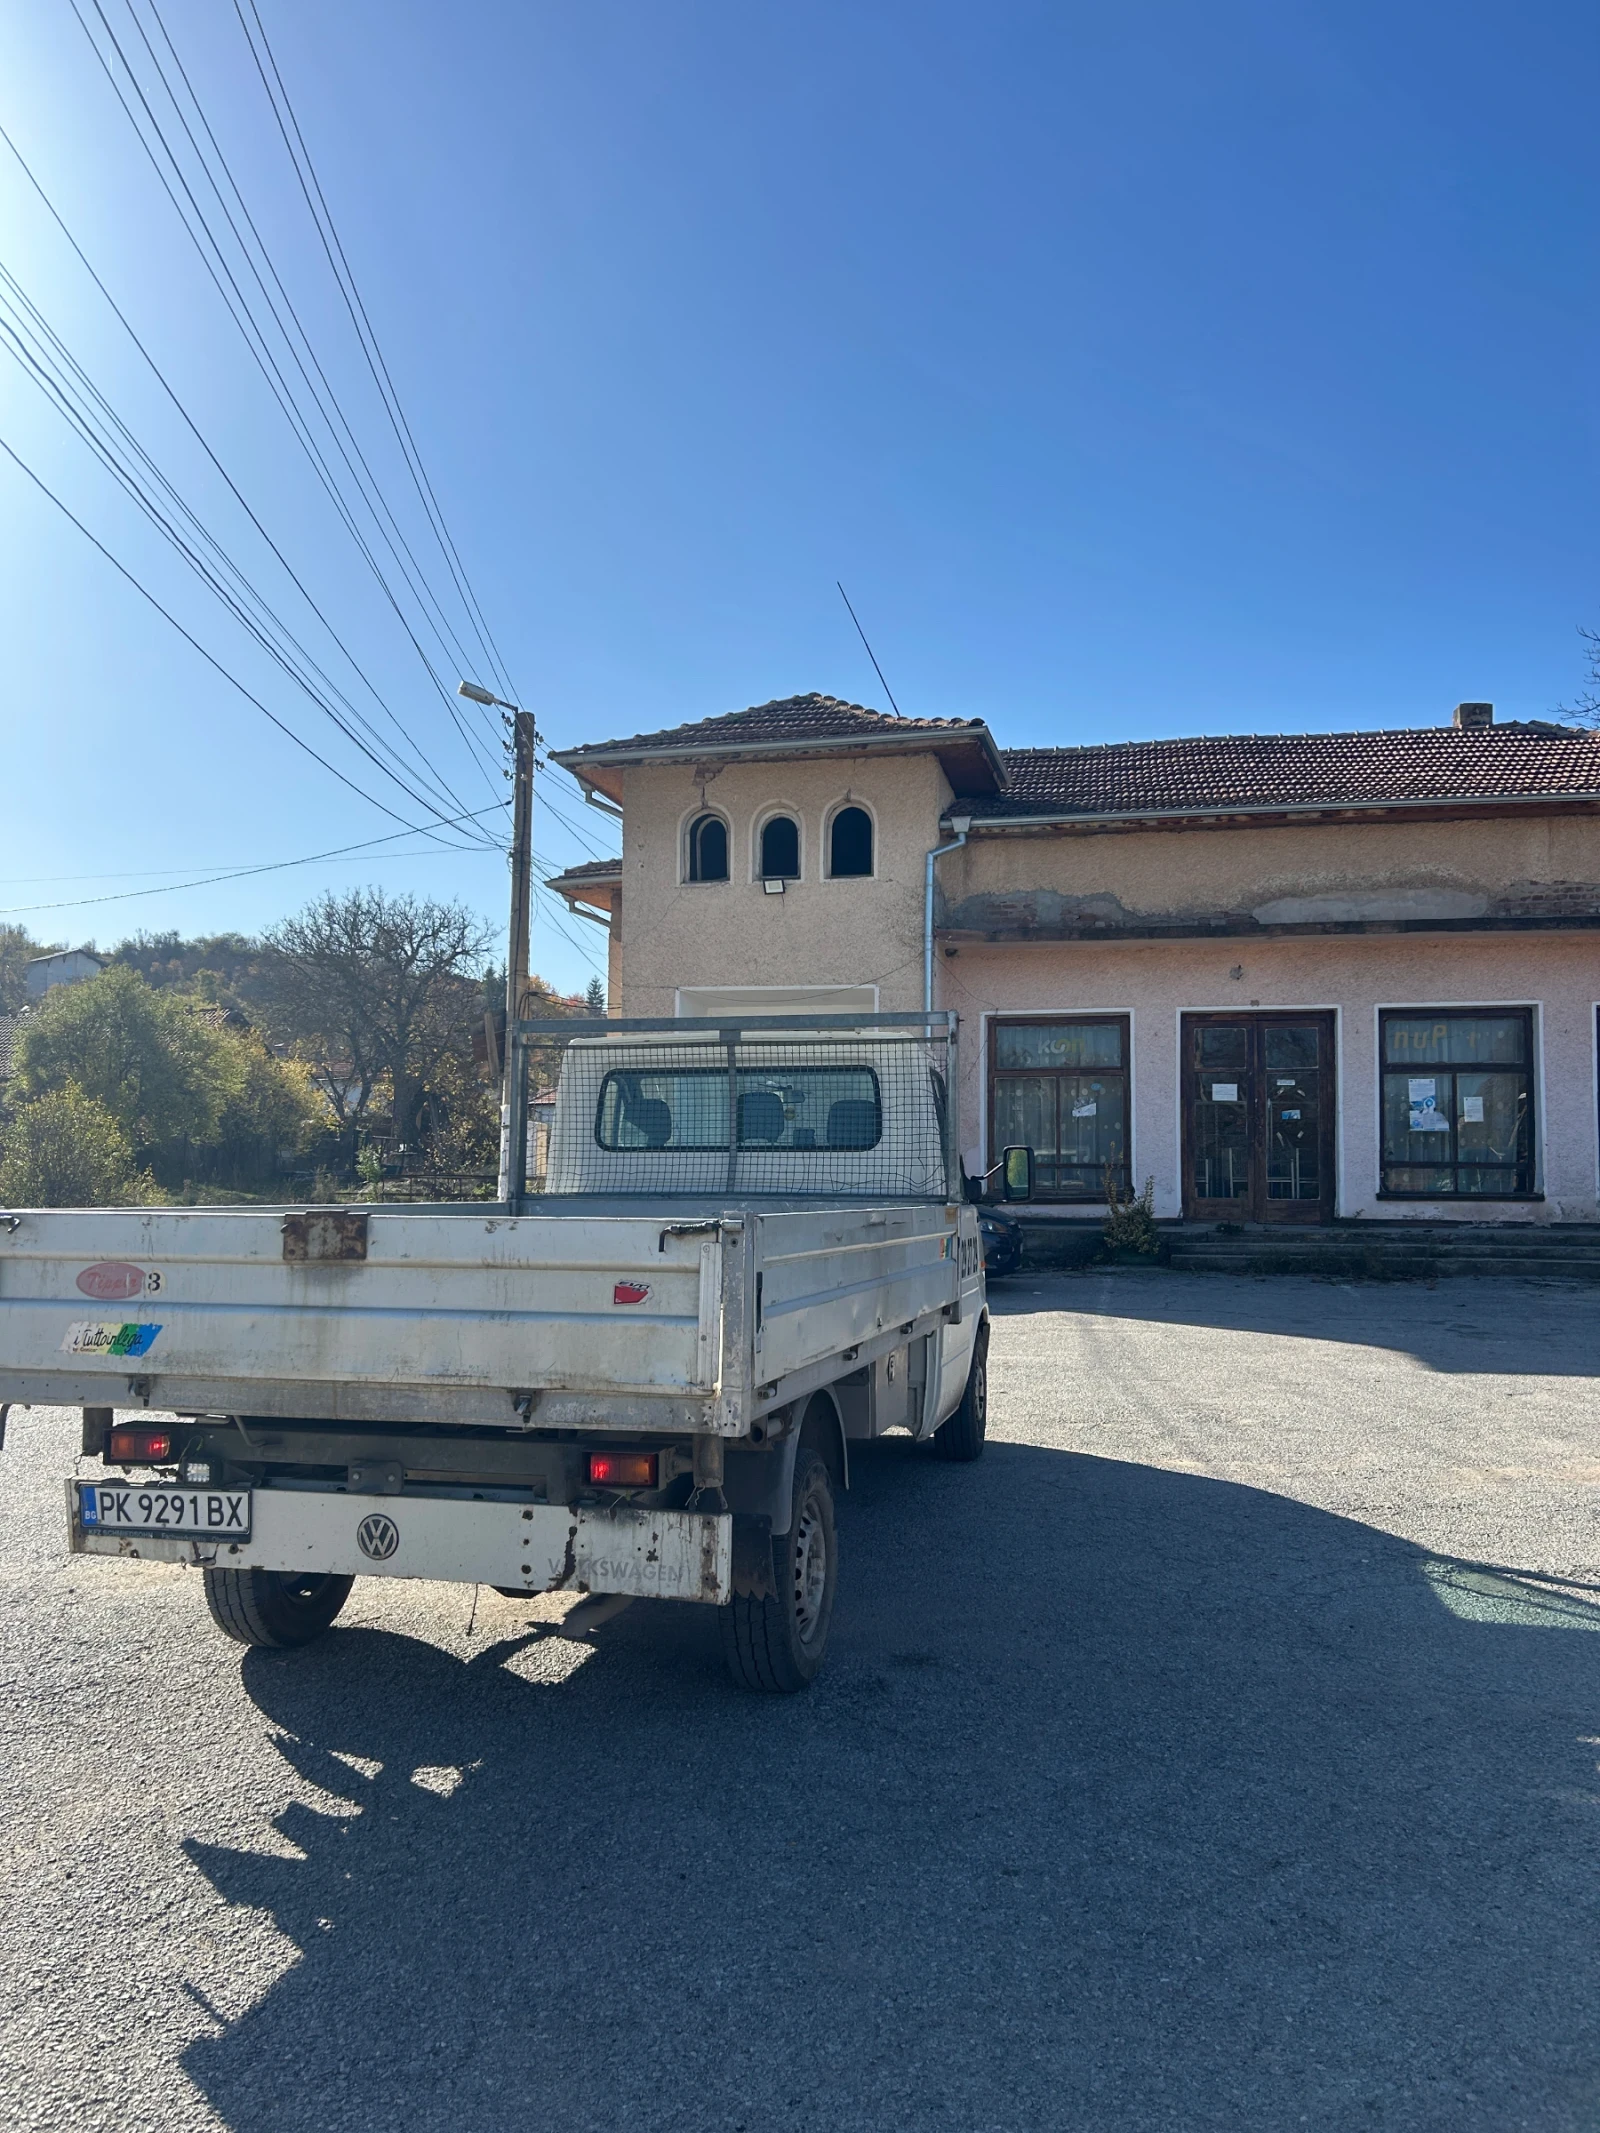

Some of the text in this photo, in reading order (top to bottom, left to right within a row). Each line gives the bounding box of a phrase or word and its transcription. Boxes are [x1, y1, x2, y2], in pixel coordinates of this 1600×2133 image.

[147, 1272, 161, 1291] 3
[85, 1510, 97, 1520] BG
[100, 1492, 243, 1527] PK 9291 BX
